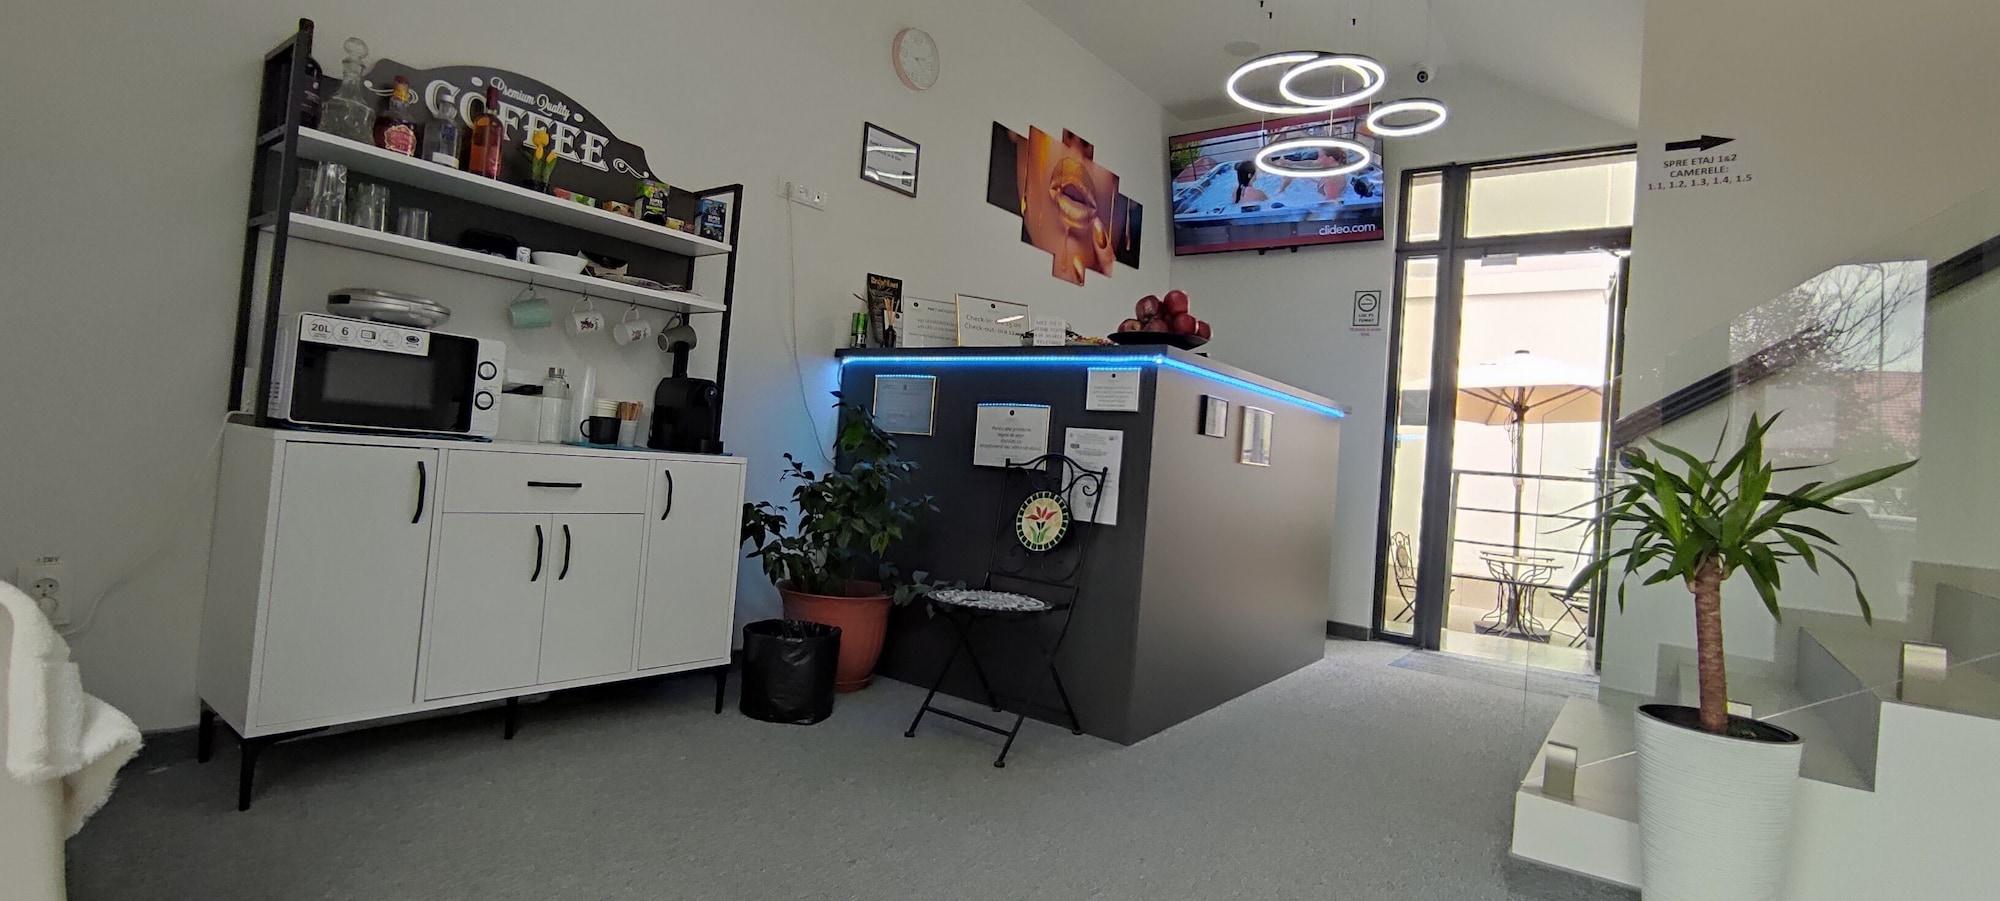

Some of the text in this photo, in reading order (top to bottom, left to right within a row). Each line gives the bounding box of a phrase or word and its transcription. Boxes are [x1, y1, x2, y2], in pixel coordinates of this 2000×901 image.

[490, 76, 571, 122] Premium Quality
[1663, 158, 1689, 169] SPRE
[1691, 156, 1714, 166] ETAJ
[1669, 165, 1729, 178] CAMERELE:
[1735, 173, 1753, 183] 1.5
[1318, 223, 1376, 236] clideo.com
[311, 323, 331, 333] 20L
[341, 327, 349, 336] 6
